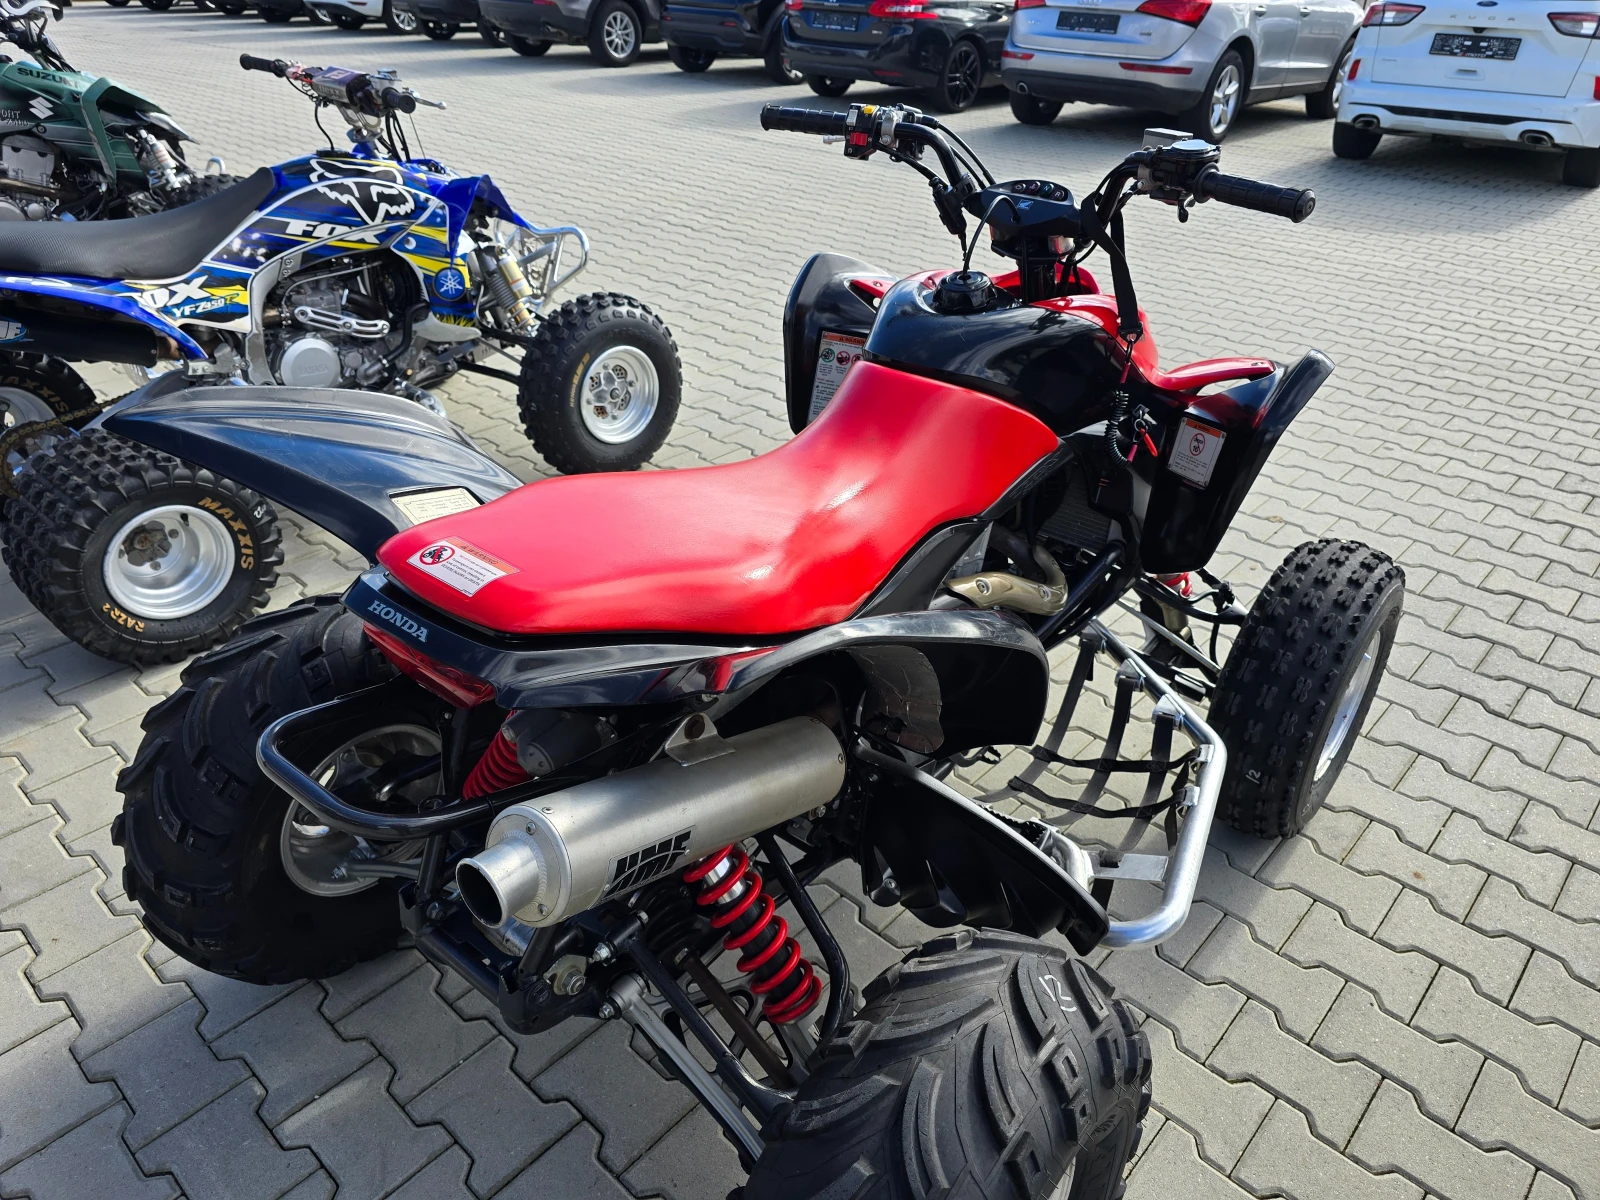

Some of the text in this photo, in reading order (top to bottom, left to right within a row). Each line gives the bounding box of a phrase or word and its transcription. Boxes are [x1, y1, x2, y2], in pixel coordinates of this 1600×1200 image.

[17, 68, 79, 88] SUZUKI
[285, 221, 387, 244] FOX
[0, 376, 69, 412] AXXIS
[197, 497, 255, 570] MAXXIS
[109, 607, 146, 633] RAZR
[367, 600, 429, 643] HONDA
